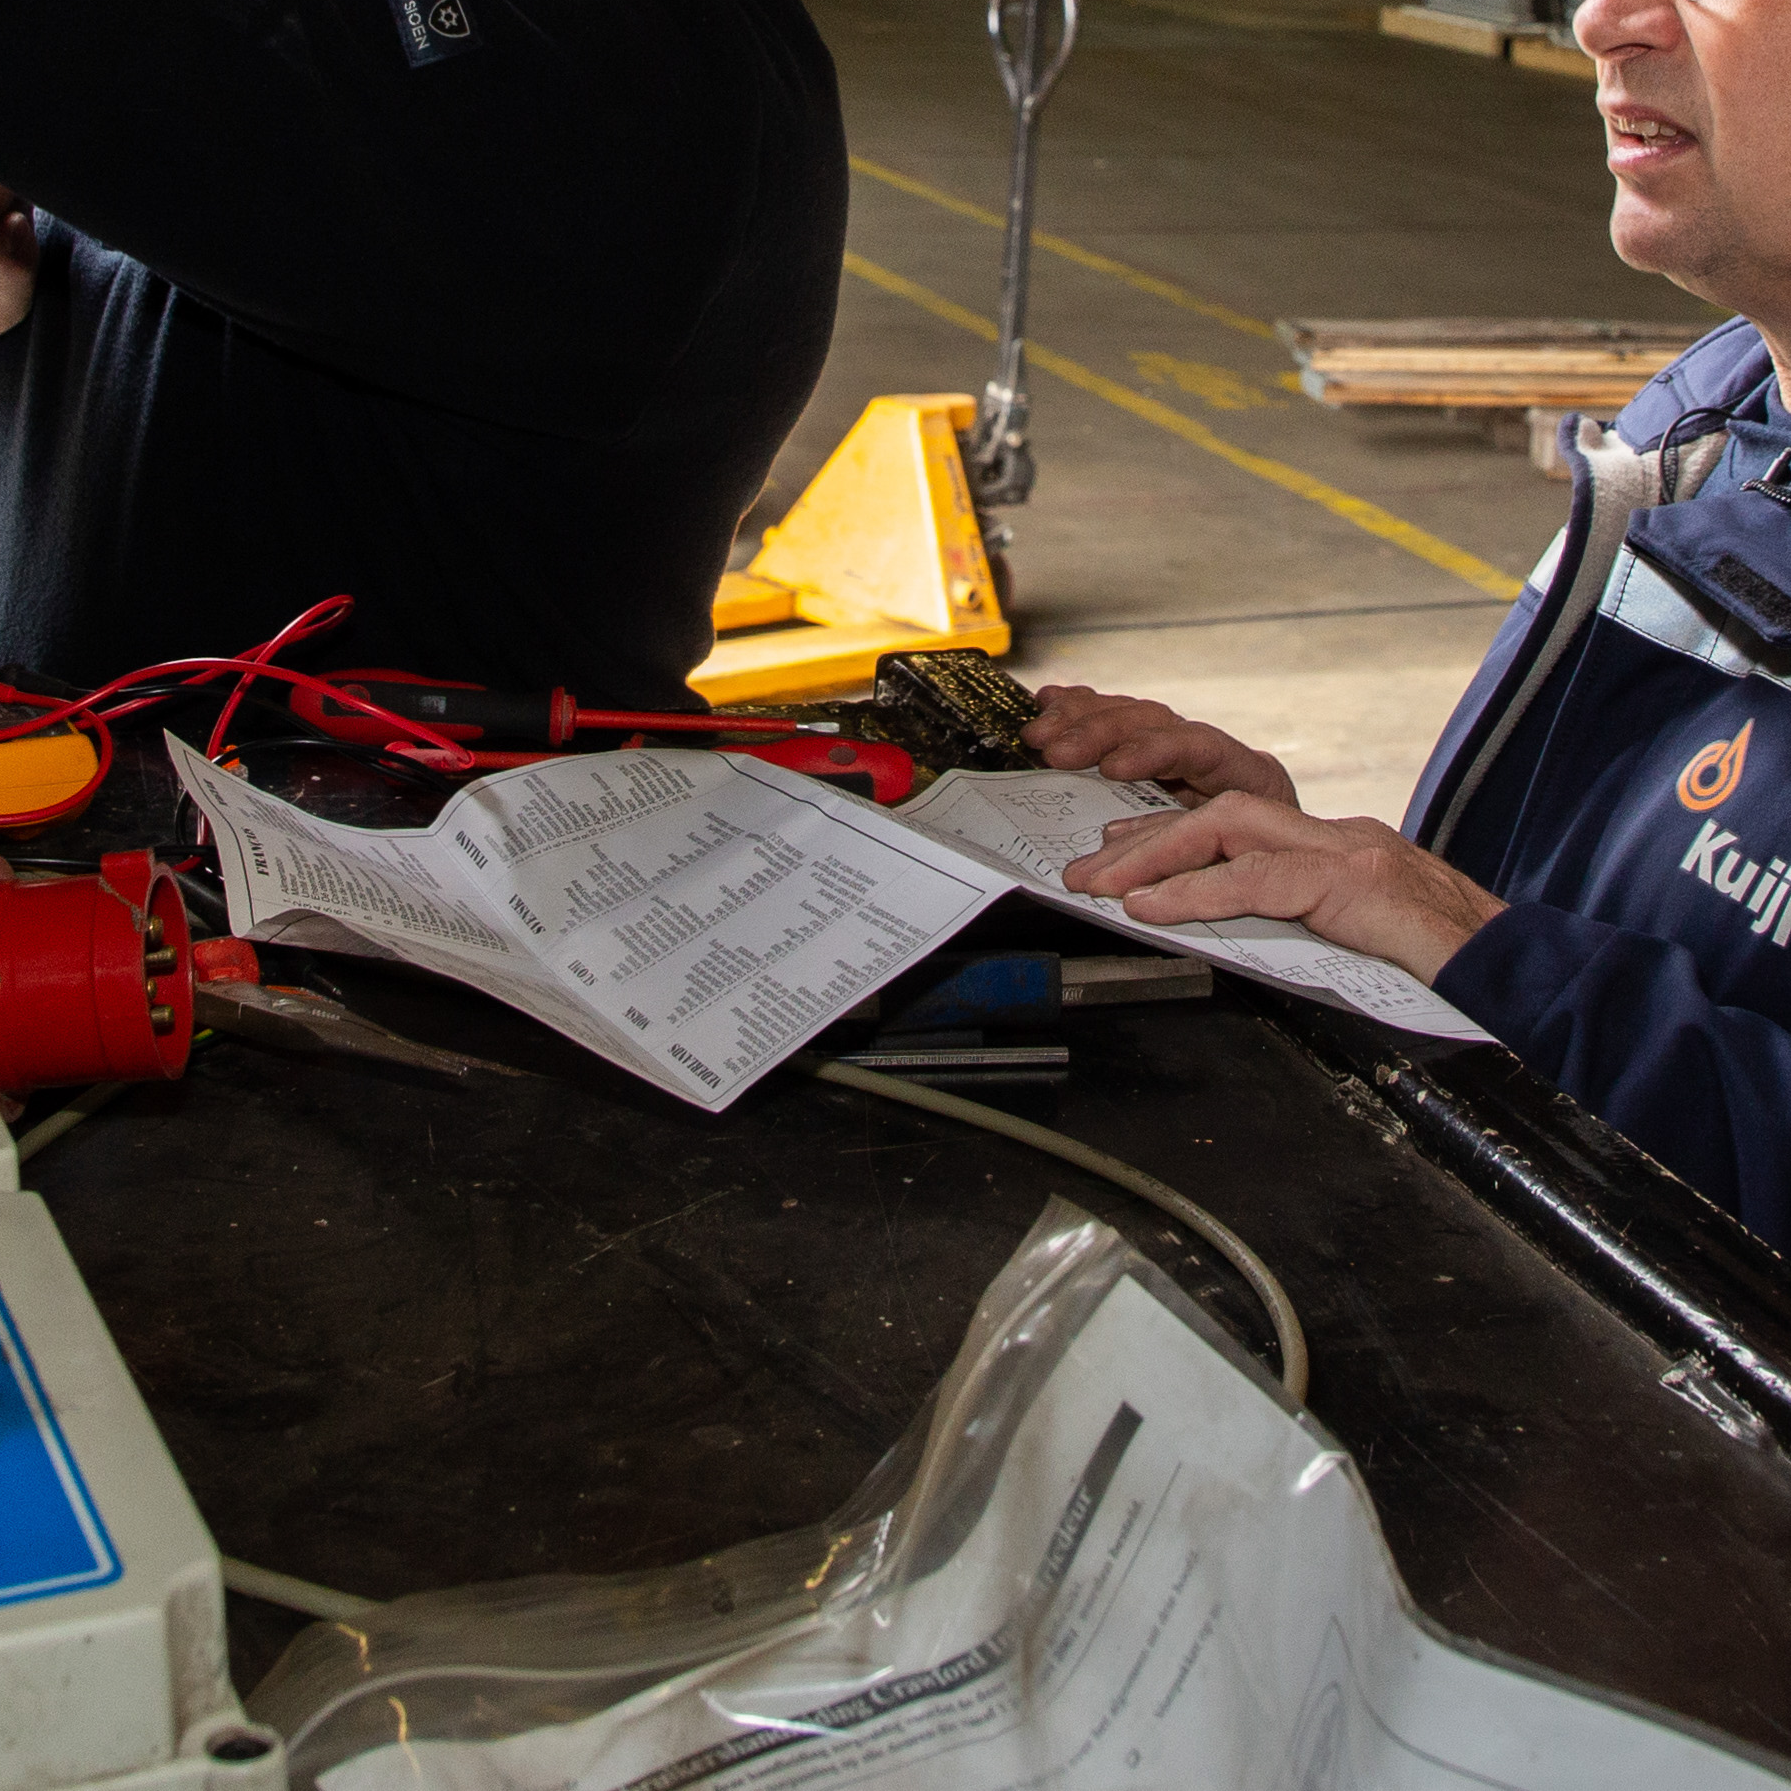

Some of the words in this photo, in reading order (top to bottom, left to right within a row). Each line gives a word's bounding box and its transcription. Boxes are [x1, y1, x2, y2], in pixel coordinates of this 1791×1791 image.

[404, 0, 430, 50] SIOEN
[455, 830, 489, 869] ITALIANO
[507, 894, 546, 934] SVENSKA
[567, 960, 598, 986] SUOMI
[624, 1005, 651, 1031] NORSK
[667, 1043, 723, 1090] NEDERLANDS
[869, 1647, 997, 1712] Crawford
